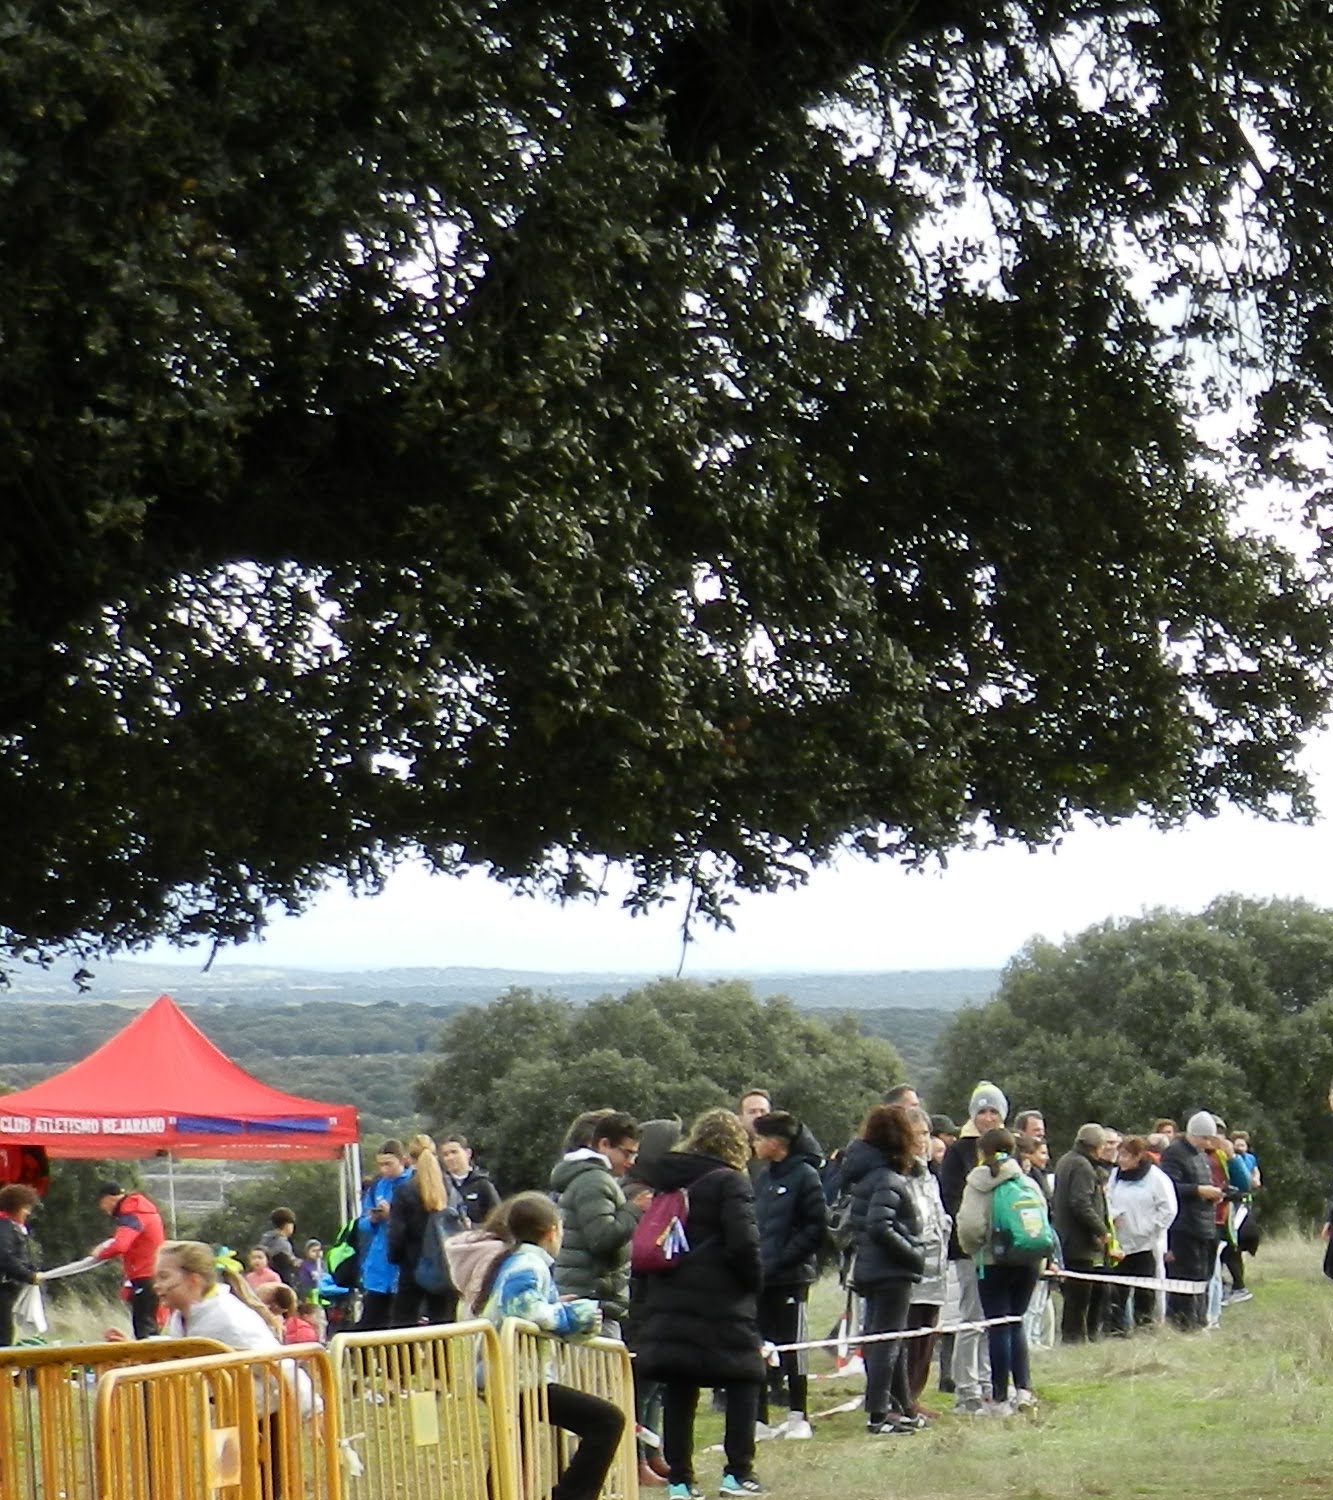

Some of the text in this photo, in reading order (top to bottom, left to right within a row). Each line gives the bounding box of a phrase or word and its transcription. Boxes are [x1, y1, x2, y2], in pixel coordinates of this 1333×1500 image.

[0, 1116, 165, 1134] CLUB ATLETISMO BEJARANO
